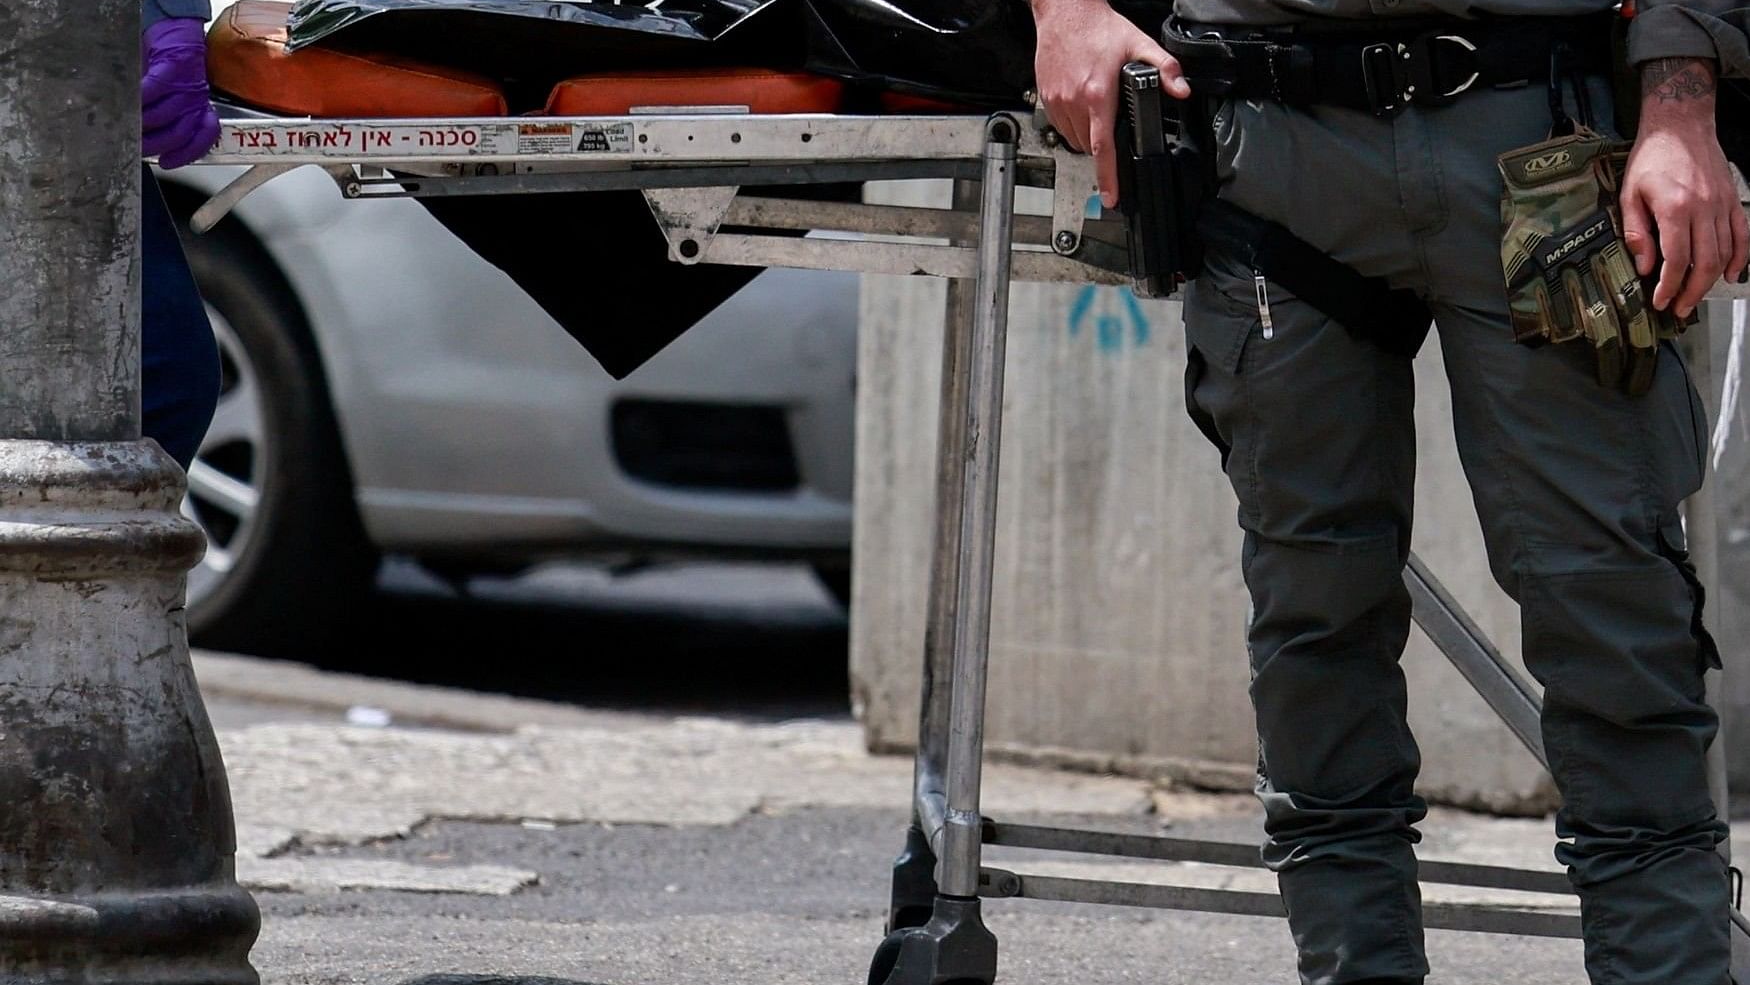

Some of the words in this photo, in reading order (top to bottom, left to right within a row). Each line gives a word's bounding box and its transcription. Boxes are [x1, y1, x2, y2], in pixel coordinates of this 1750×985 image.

[231, 129, 278, 148] בצד
[287, 127, 351, 148] לאחוז
[361, 130, 392, 152] אין
[419, 129, 477, 147] סכנה
